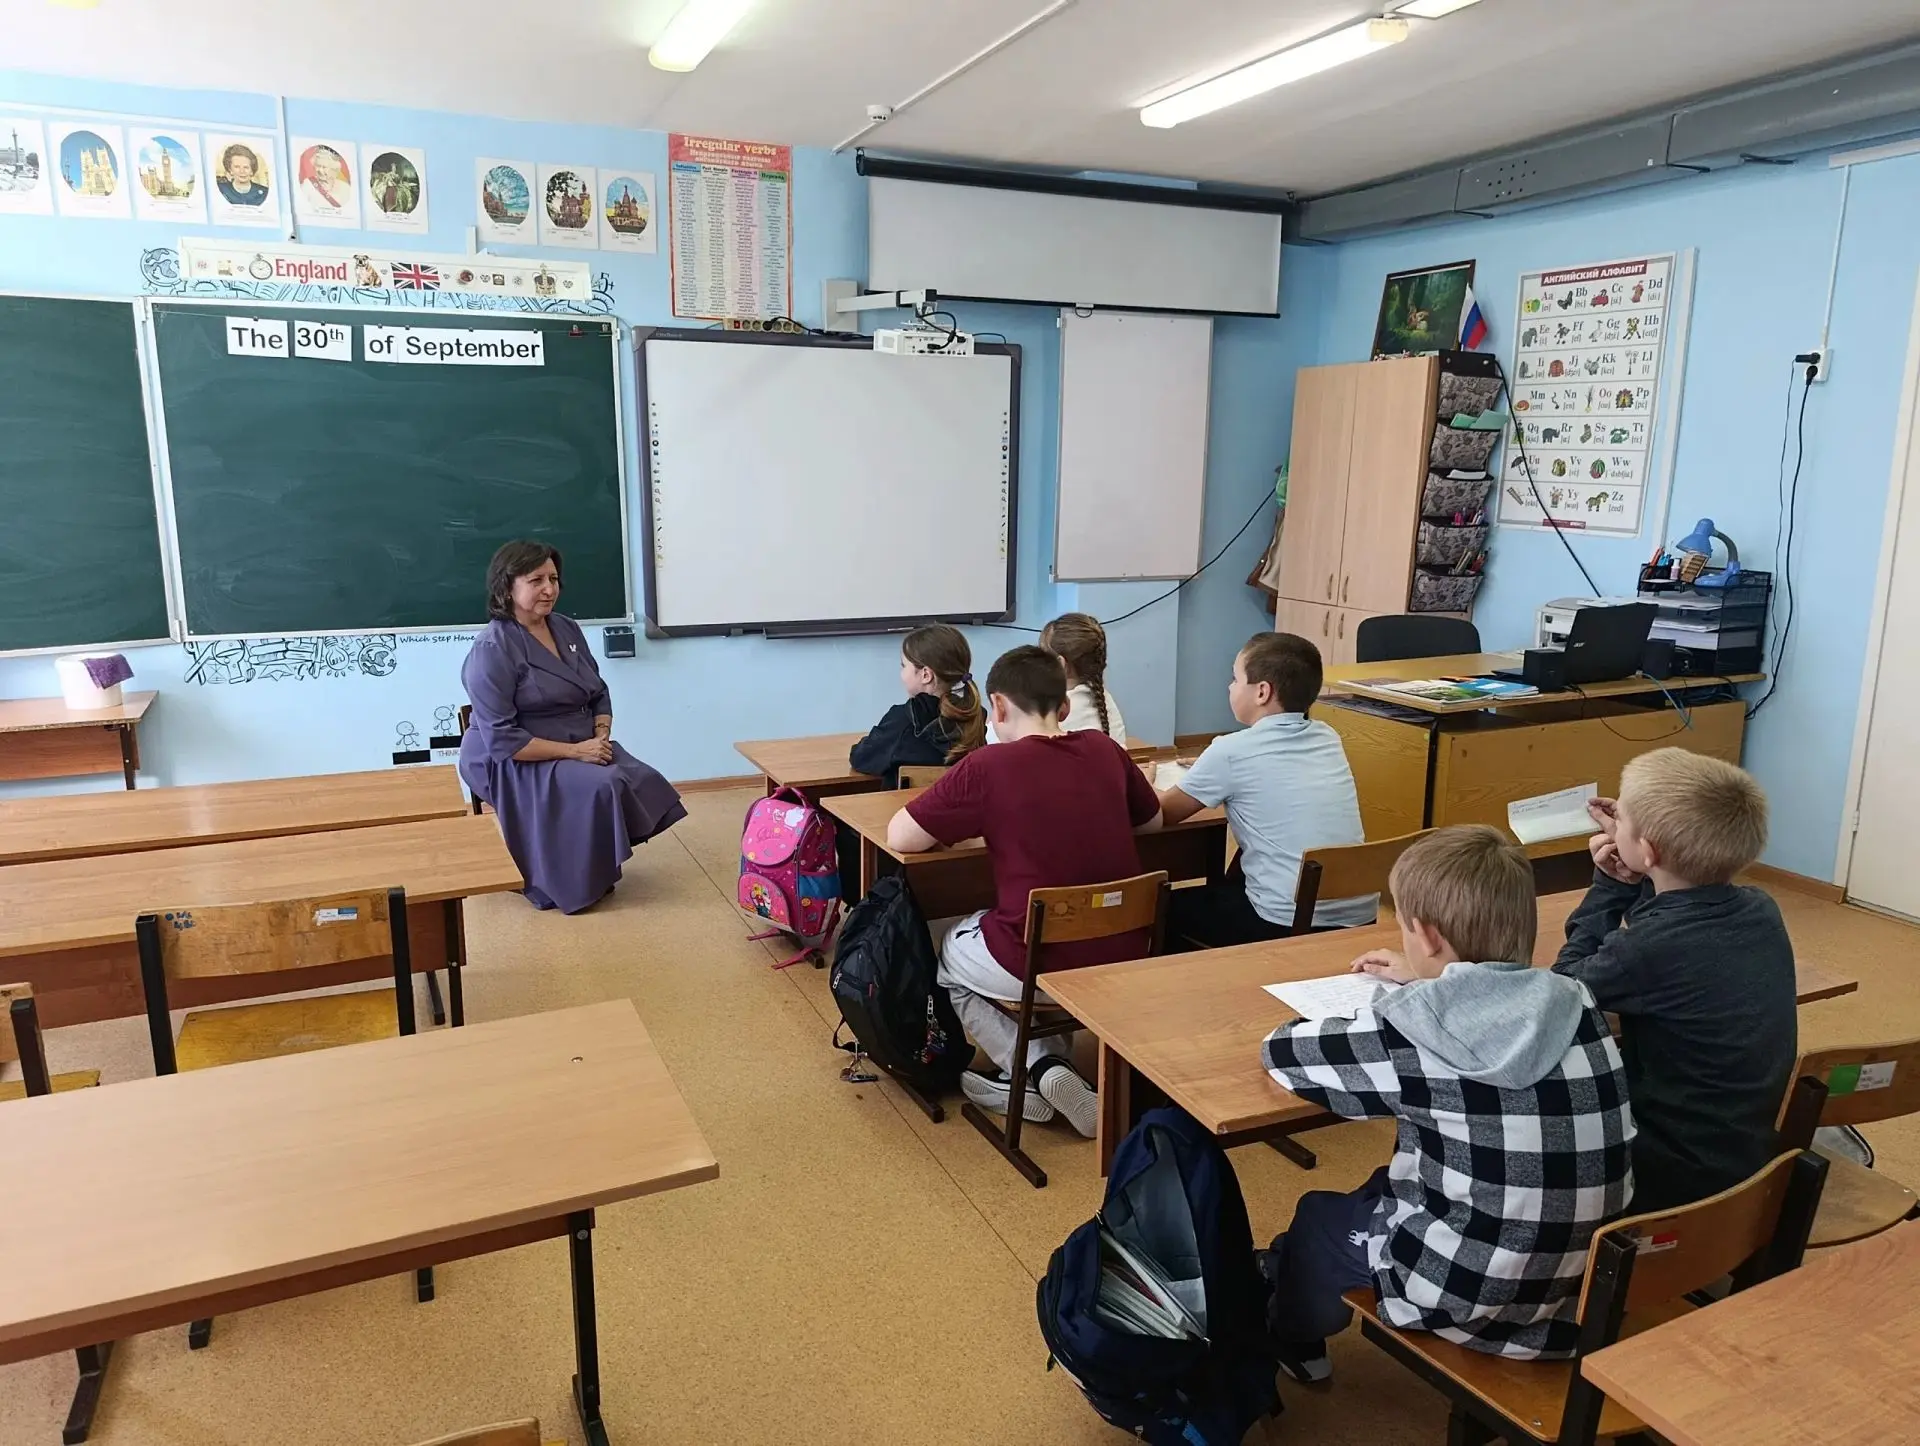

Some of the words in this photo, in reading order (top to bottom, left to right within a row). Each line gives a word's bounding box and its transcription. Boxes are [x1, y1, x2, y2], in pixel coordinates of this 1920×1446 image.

[683, 136, 741, 153] Irregular
[744, 144, 777, 156] verbs
[275, 258, 347, 284] England
[1543, 270, 1599, 284] АНГЛИЙСКИЙ
[1601, 264, 1644, 278] АЛФАВИТ
[1611, 283, 1623, 293] Cc
[1648, 279, 1663, 289] Dd
[1541, 291, 1554, 301] Aa
[1575, 287, 1588, 297] Bb
[1606, 318, 1620, 330] Gg
[1643, 315, 1659, 326] Hh
[1539, 325, 1550, 334] Ee
[1572, 321, 1585, 331] Ff
[231, 327, 284, 351] The
[297, 328, 344, 350] 30th
[369, 334, 393, 355] of
[406, 336, 541, 361] September
[1568, 354, 1579, 366] Jj
[1602, 353, 1616, 364] Kk
[1642, 351, 1652, 361] Ll
[1530, 390, 1545, 399] Mm
[1564, 390, 1577, 399] Nn
[1599, 389, 1612, 398] Oo
[1636, 388, 1650, 399] Pp
[1527, 423, 1539, 433] Qq
[1561, 423, 1573, 432] Rr
[1595, 423, 1606, 432] Ss
[1633, 423, 1644, 432] Tt
[1528, 455, 1540, 465] Uu
[1570, 456, 1582, 465] Vv
[1612, 456, 1631, 466] Ww
[1568, 489, 1580, 501] Yy
[1611, 491, 1624, 501] Zz
[399, 634, 431, 644] Which
[453, 633, 476, 642] Have
